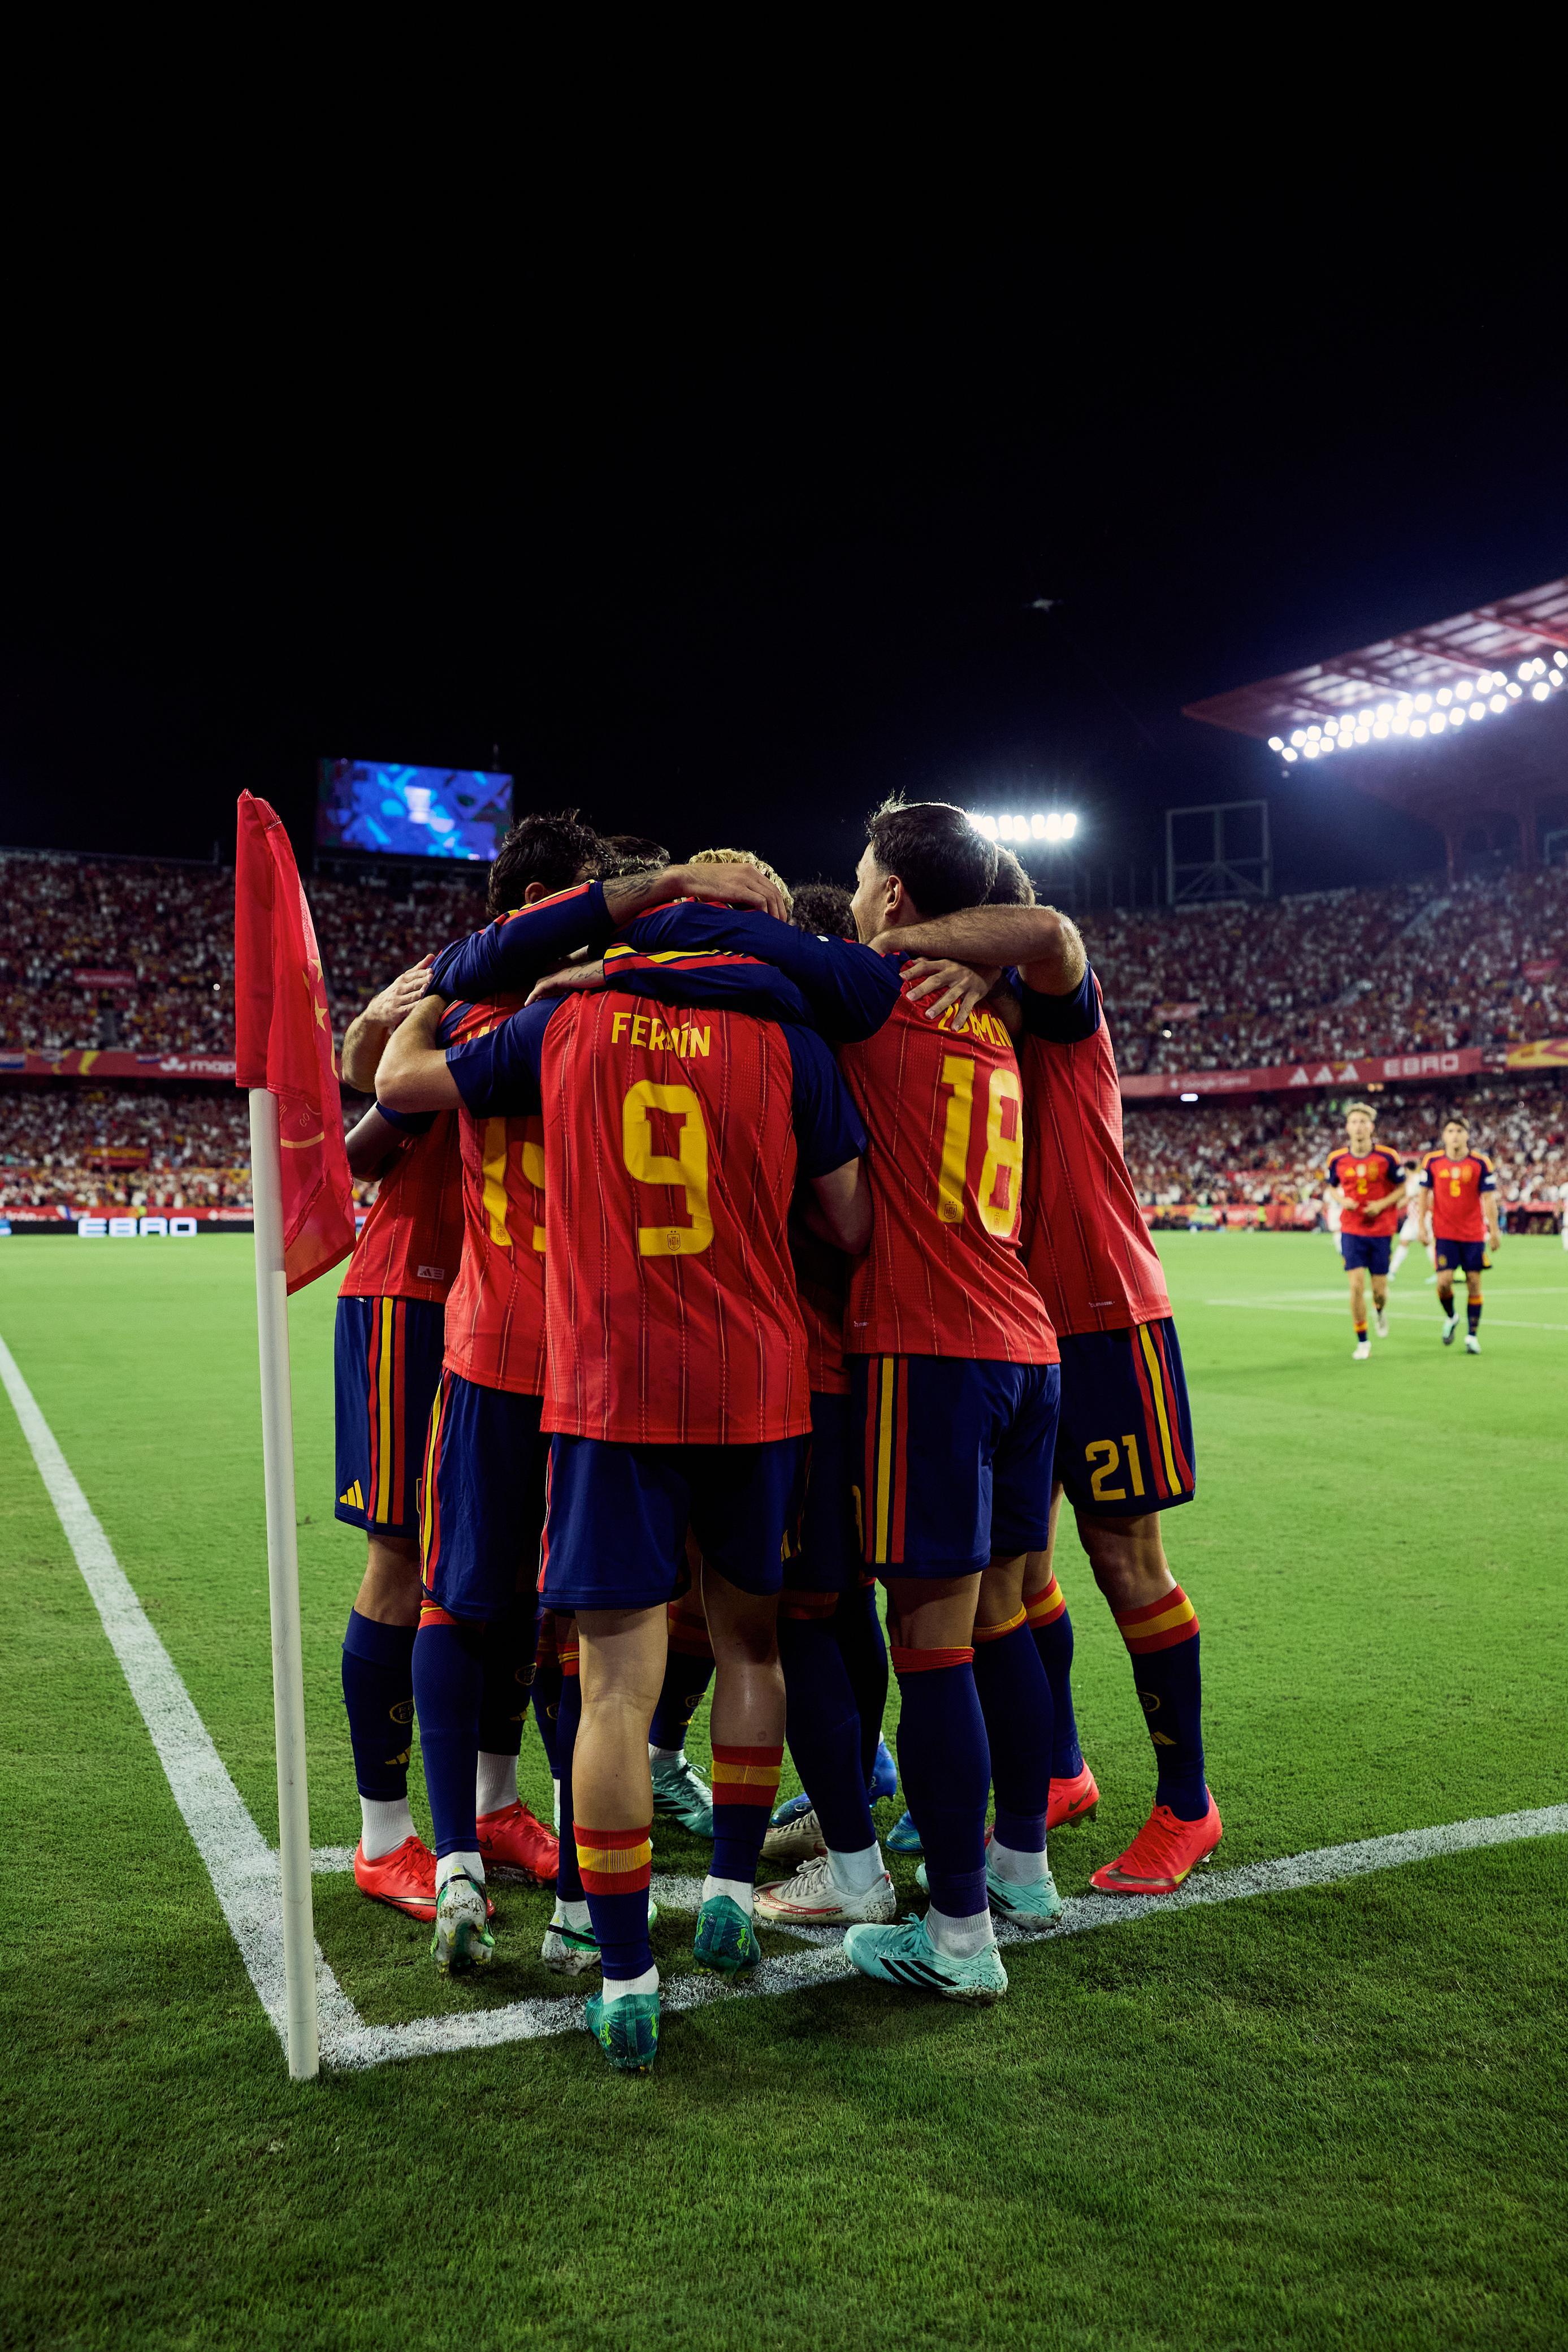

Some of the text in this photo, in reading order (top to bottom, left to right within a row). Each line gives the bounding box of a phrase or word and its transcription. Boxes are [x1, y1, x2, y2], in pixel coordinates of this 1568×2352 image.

[611, 1011, 711, 1059] FERMÍN
[622, 1079, 714, 1256] 9
[936, 1055, 1024, 1238] 18
[1085, 1434, 1145, 1501] 21
